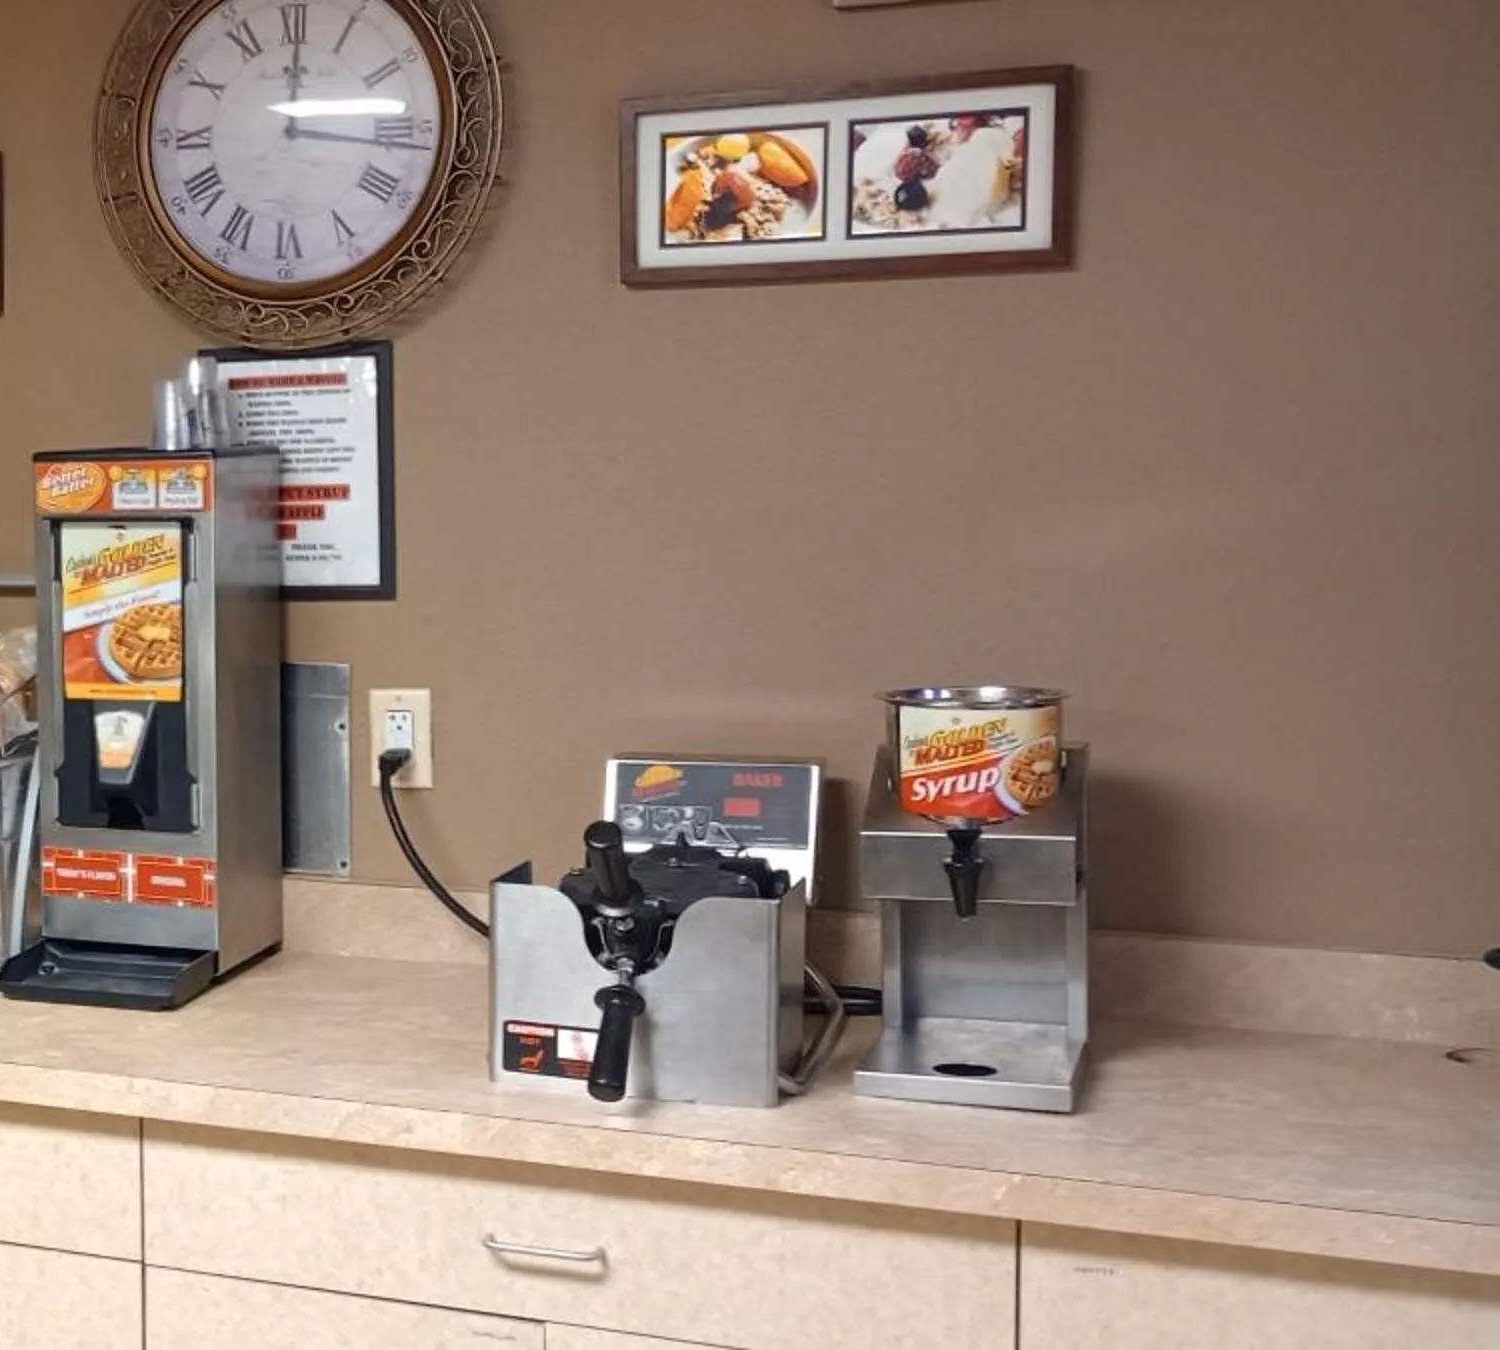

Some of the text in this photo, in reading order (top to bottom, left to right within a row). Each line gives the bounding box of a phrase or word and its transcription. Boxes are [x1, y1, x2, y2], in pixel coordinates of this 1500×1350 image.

[226, 18, 264, 64] XI
[279, 3, 309, 46] XII
[176, 126, 213, 151] IX
[275, 220, 304, 260] VI
[732, 772, 786, 787] BAKER
[911, 767, 999, 803] Syrup
